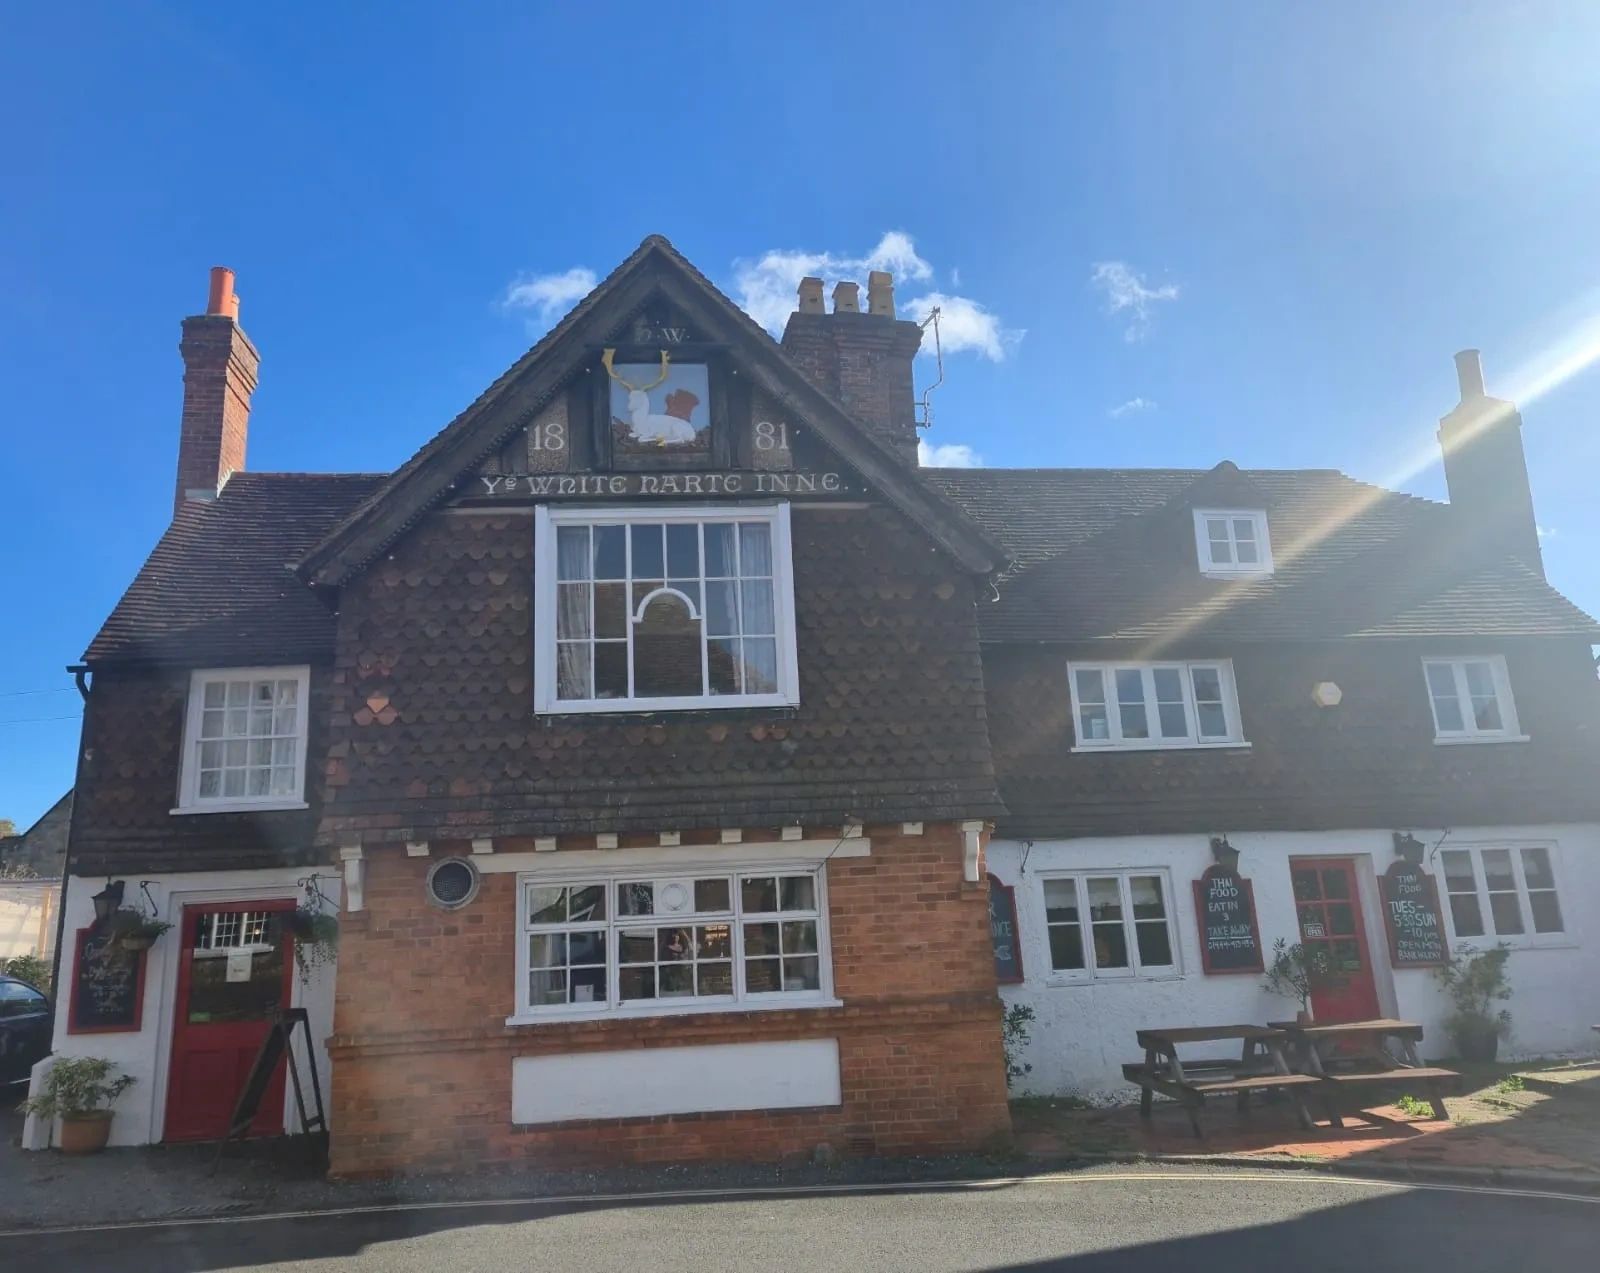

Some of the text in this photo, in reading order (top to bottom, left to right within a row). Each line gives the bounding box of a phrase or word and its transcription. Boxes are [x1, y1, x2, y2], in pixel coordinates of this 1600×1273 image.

[532, 423, 565, 450] 18
[755, 421, 790, 449] 81
[1210, 888, 1239, 899] FOOD
[1415, 913, 1437, 927] SUN
